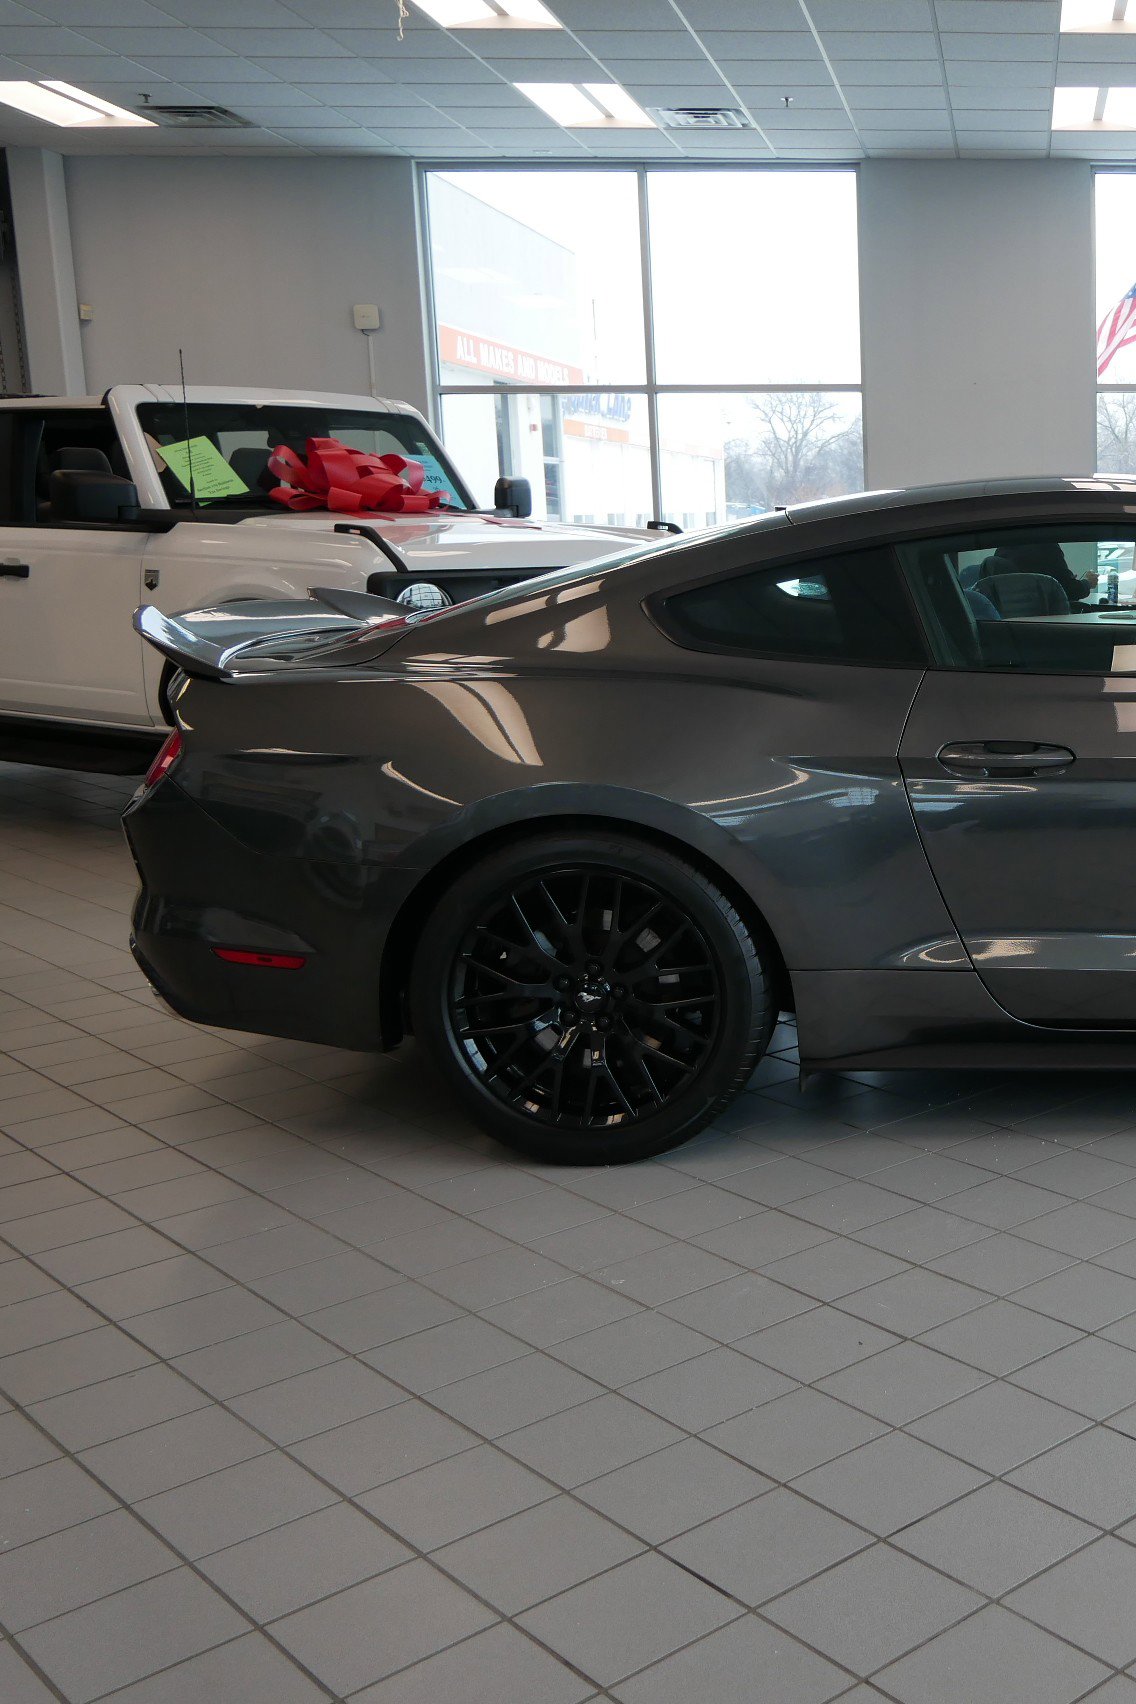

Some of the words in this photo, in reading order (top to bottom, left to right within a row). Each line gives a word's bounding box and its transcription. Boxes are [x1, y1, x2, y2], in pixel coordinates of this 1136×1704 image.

[456, 335, 477, 364] ALL
[479, 343, 515, 374] MAKES
[517, 354, 536, 379] AND
[537, 360, 570, 385] MODELS
